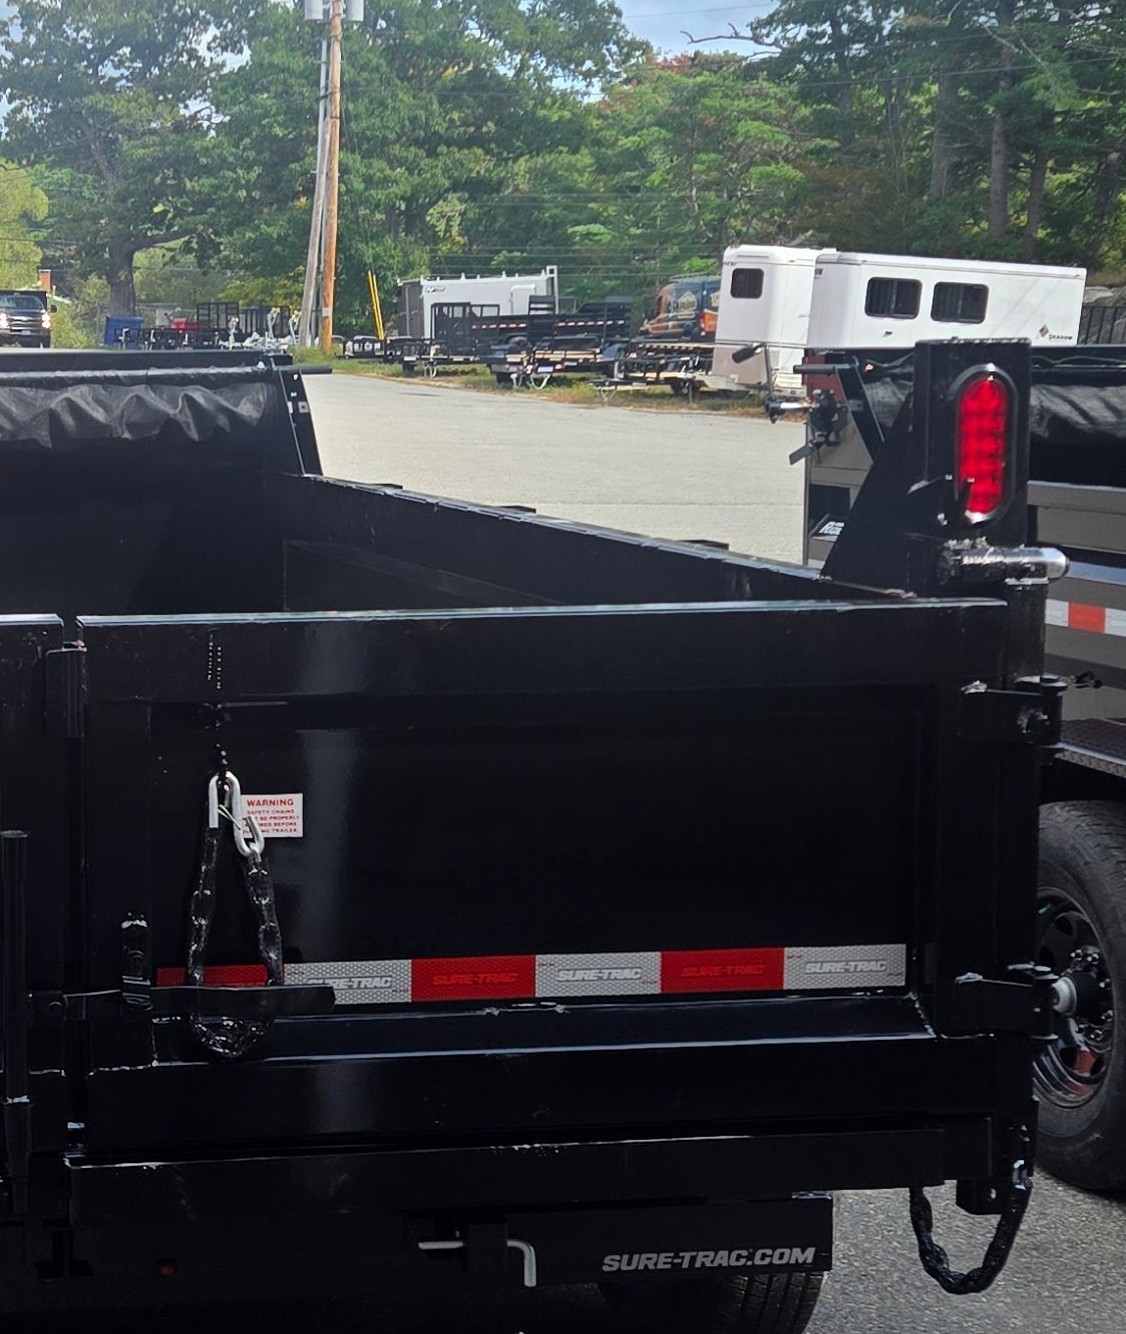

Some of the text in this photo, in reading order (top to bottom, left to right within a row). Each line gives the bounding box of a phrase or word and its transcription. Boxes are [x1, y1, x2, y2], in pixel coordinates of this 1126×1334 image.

[432, 972, 518, 985] SURE-TRAC
[558, 968, 643, 981] SURE-TRAC
[681, 963, 765, 977] SURE-TRAC
[805, 960, 887, 973] SURE-TRAC
[602, 1247, 816, 1272] SURE-TRAC.COM
